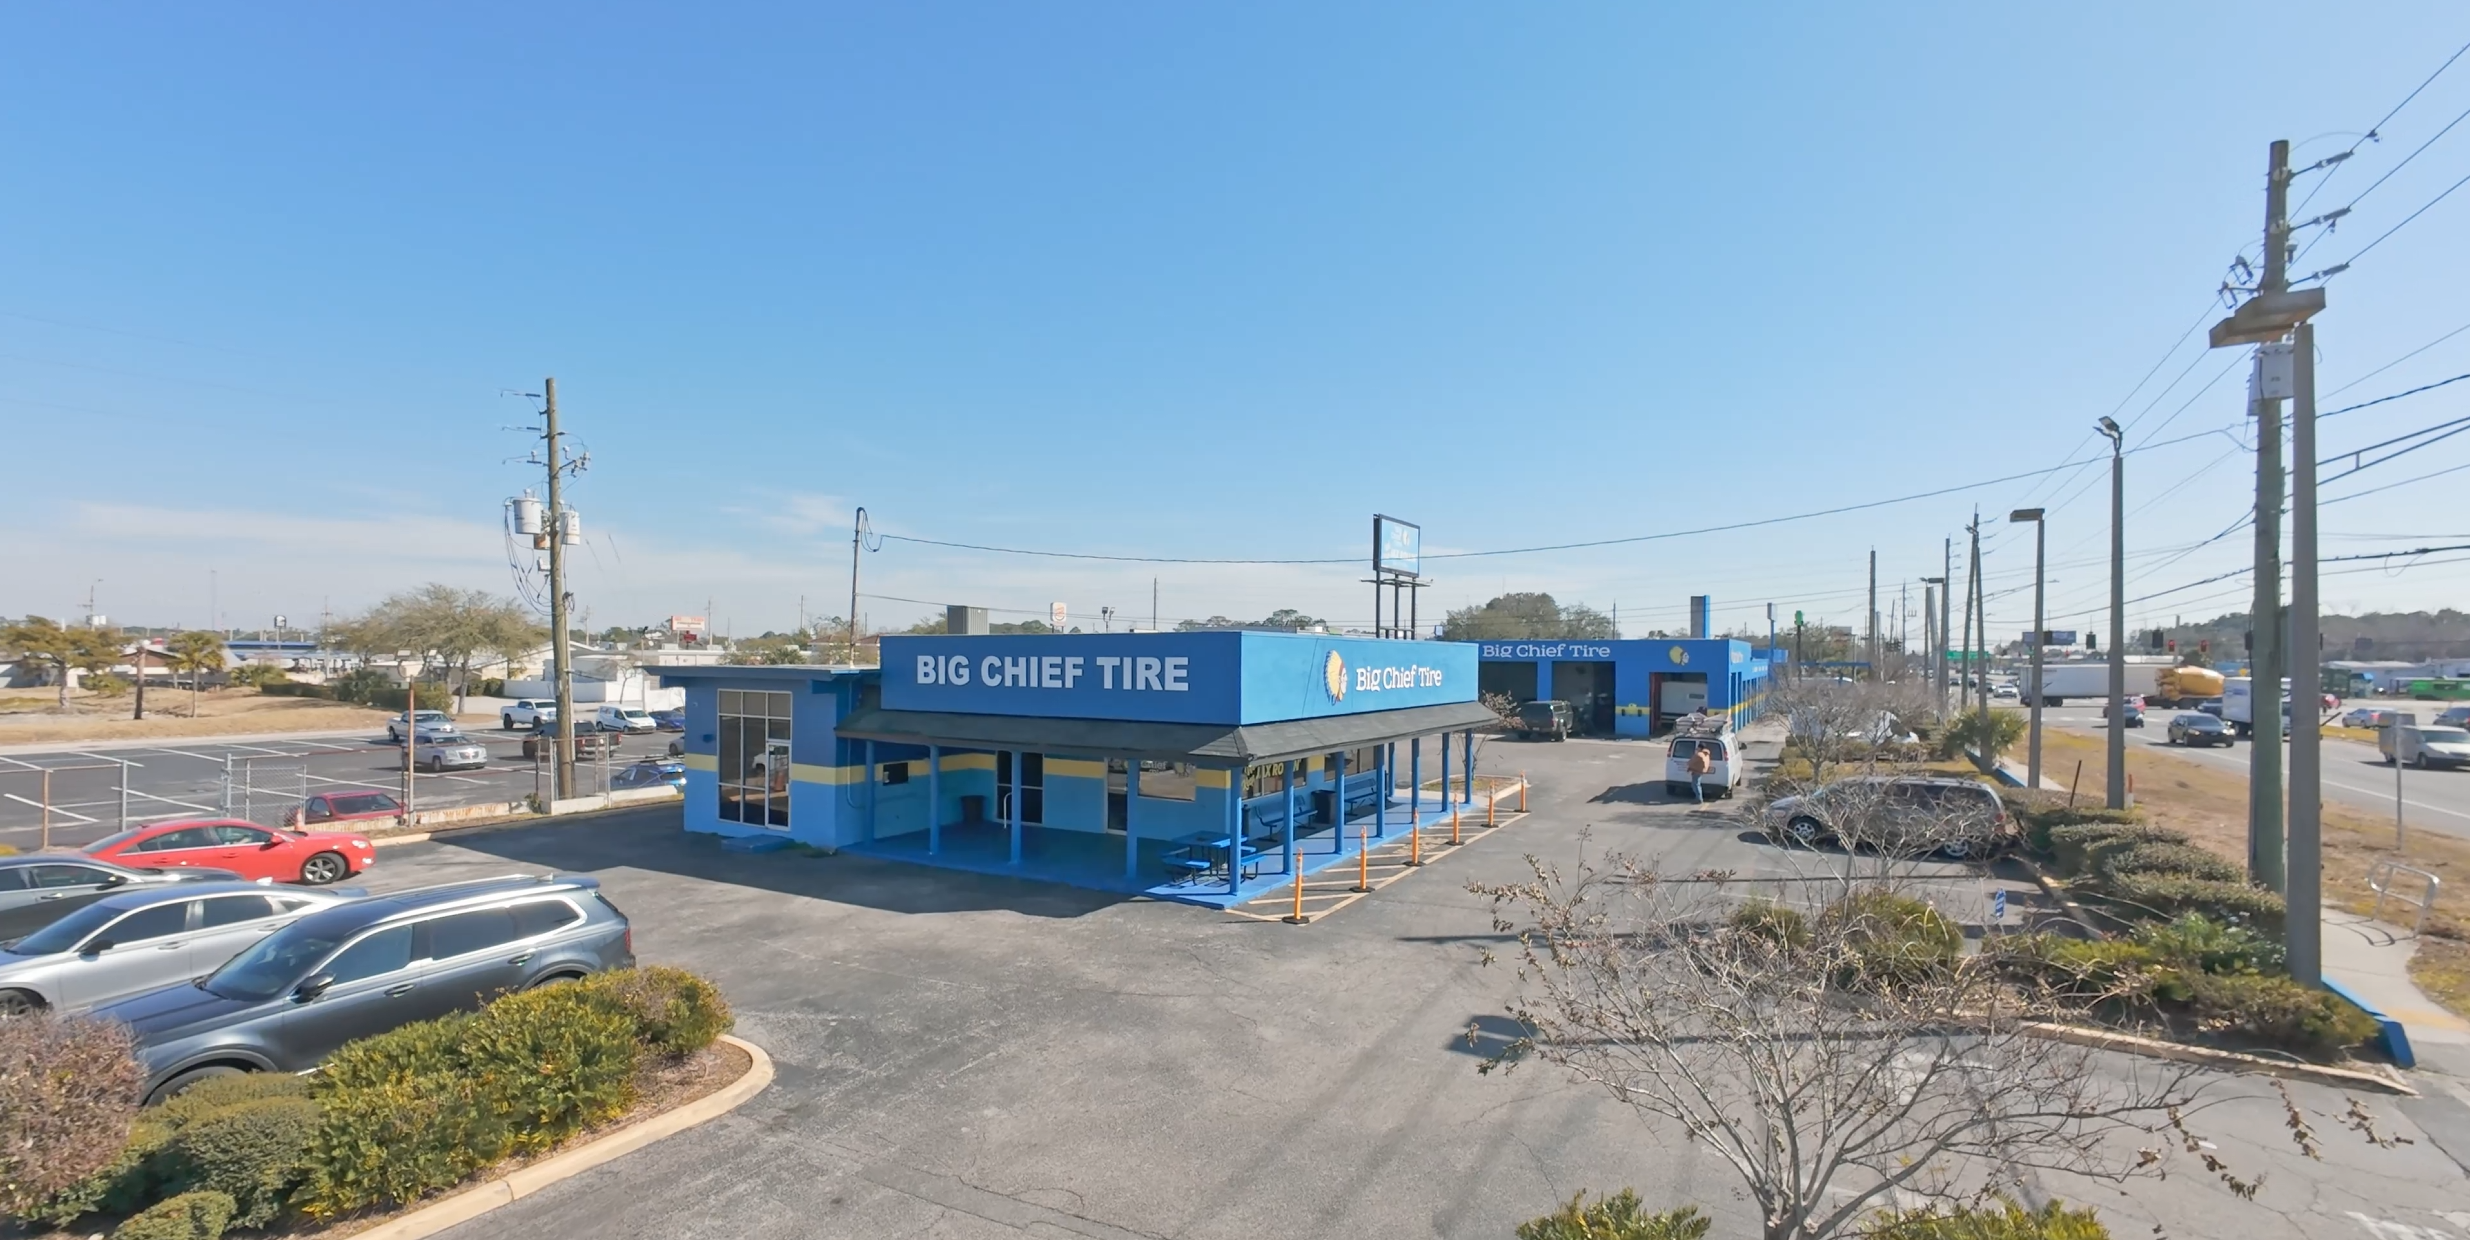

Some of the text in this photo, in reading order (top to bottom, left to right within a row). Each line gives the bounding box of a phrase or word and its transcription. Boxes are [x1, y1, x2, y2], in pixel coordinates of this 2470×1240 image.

[1482, 643, 1611, 658] Big Chief Tire
[916, 655, 1189, 691] BIG CHIEF TIRE
[1355, 664, 1442, 692] Big Chief Tire
